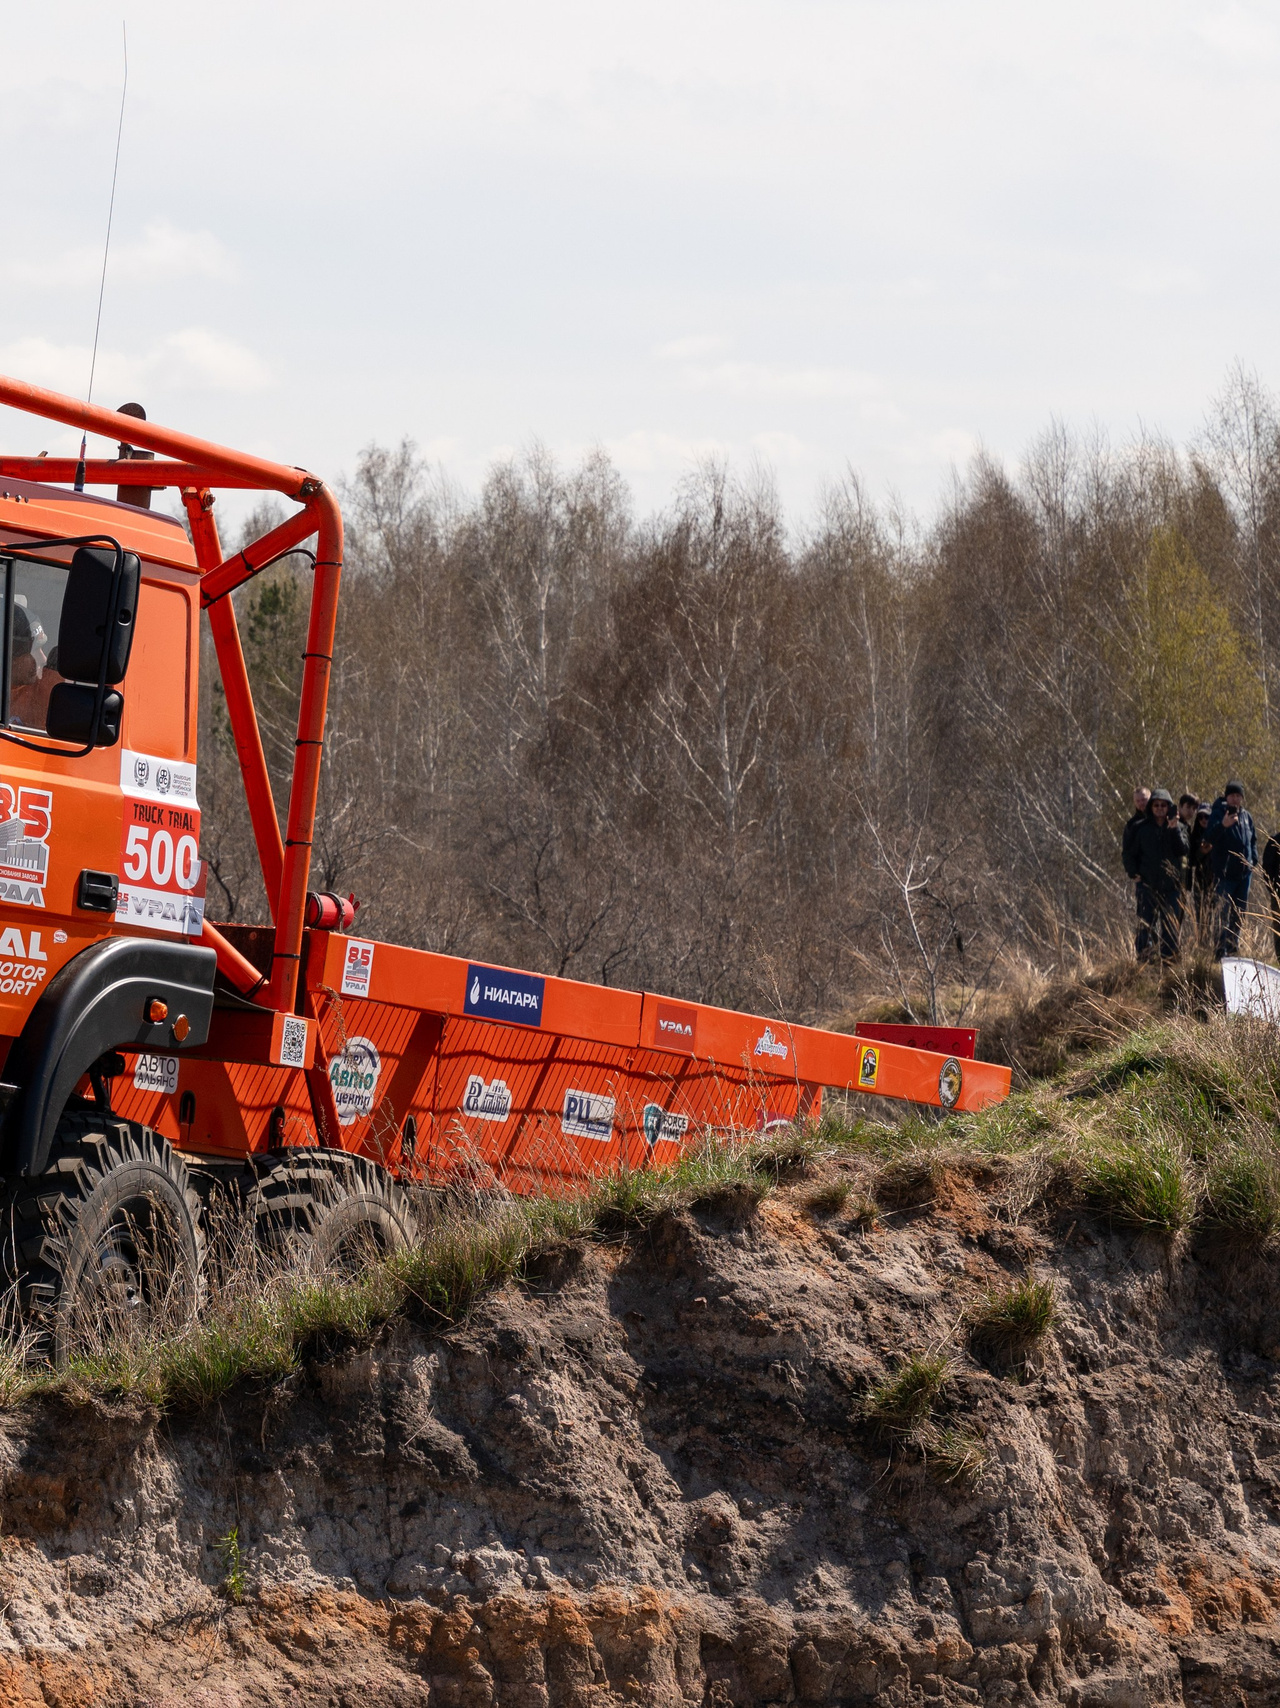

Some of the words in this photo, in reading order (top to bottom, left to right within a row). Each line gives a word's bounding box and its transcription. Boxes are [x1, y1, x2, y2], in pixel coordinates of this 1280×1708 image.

[133, 802, 164, 826] TRUCK
[168, 810, 196, 832] TRIAL
[123, 824, 202, 890] 500
[348, 946, 371, 967] 85
[345, 981, 367, 991] УРАЛ
[483, 985, 539, 1010] НИАГАРА
[659, 1019, 693, 1036] УРАЛ
[138, 1054, 177, 1075] АВТО
[137, 1072, 175, 1088] АЛЬЯНС
[335, 1092, 371, 1110] центр
[662, 1126, 681, 1140] TIME
